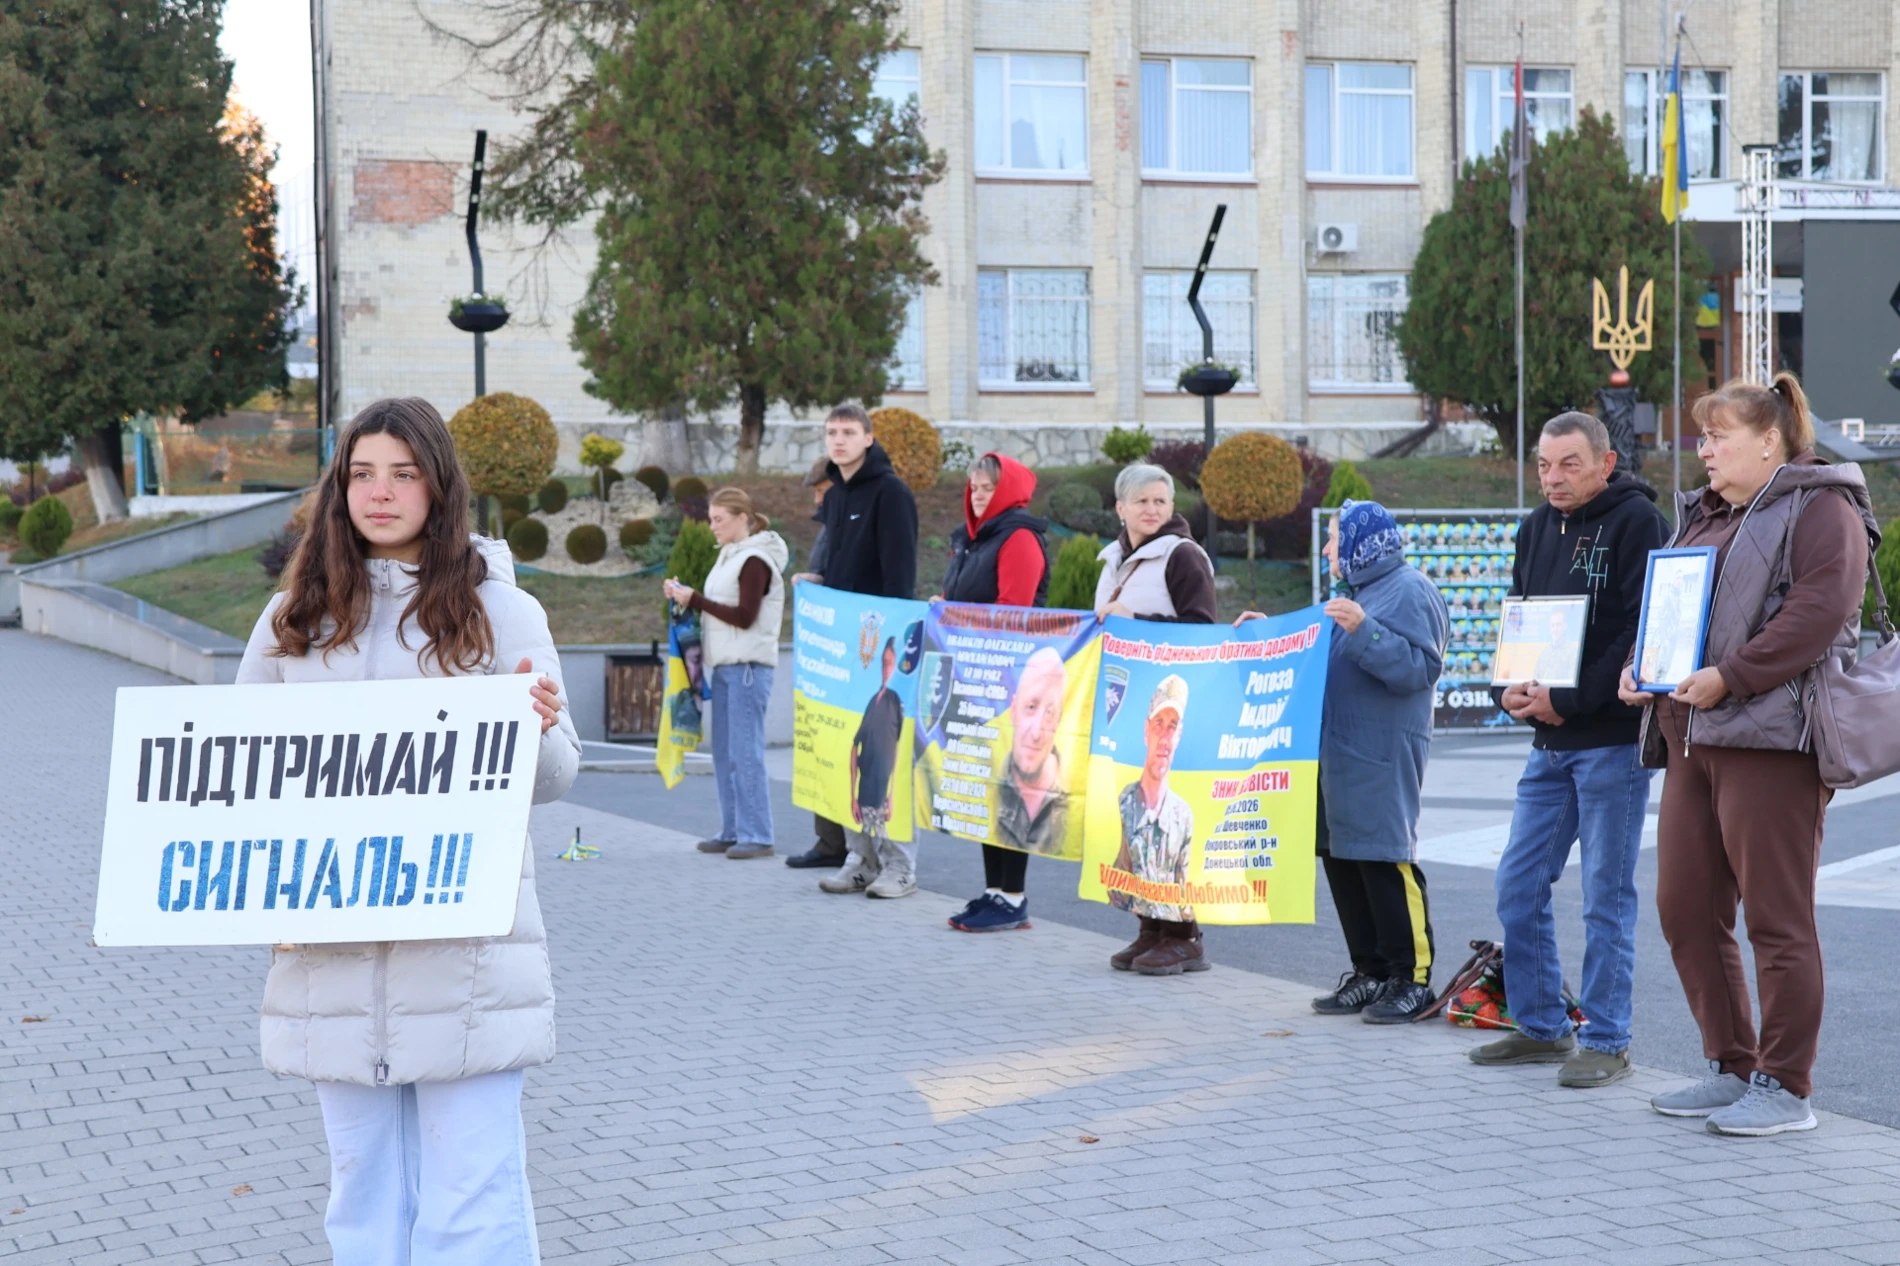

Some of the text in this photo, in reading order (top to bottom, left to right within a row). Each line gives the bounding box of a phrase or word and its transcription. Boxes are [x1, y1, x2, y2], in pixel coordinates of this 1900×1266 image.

[1219, 640, 1263, 660] братика
[1265, 631, 1306, 658] додому
[1245, 667, 1294, 695] Рогоза
[1238, 695, 1290, 729] Андрій
[1185, 881, 1249, 904] Любимо
